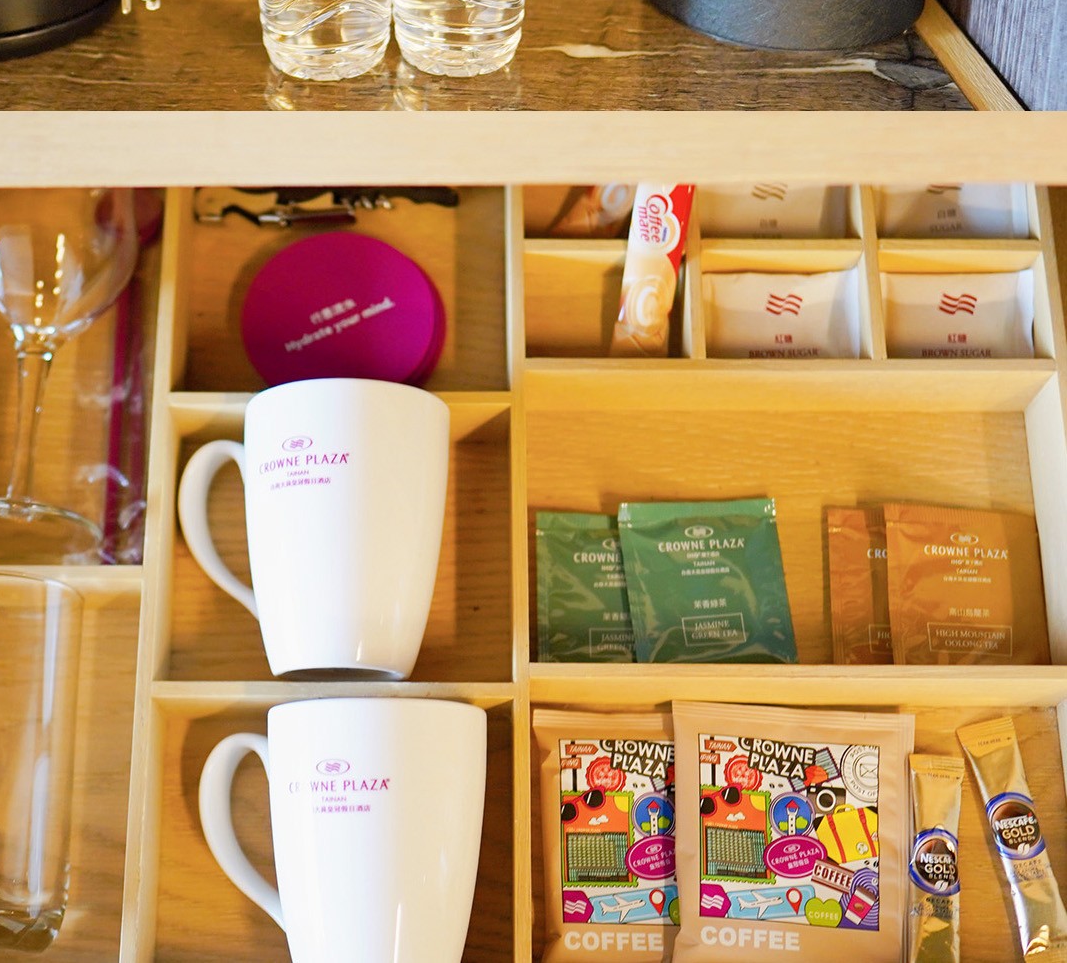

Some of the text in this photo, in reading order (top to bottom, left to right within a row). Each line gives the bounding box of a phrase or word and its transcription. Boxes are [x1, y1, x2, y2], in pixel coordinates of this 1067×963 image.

[284, 326, 334, 353] Hydrate
[333, 313, 361, 334] your
[748, 346, 821, 359] BROWN SUGAR
[921, 348, 993, 359] BROWN SUGAR
[259, 453, 349, 475] CROWNE PLAZA
[658, 538, 745, 553] CROWNE PLAZA
[924, 545, 1008, 560] CROWNE PLAZA
[695, 620, 730, 631] JASMINE
[692, 630, 722, 640] GREEN
[936, 629, 1006, 640] HIGH MOUNTAIN
[944, 640, 982, 648] OOLONG
[569, 744, 594, 753] TAINAN
[602, 740, 675, 762] CROWNE
[708, 741, 732, 750] TAINAN
[740, 738, 815, 764] CROWNE
[612, 753, 667, 779] PLAZA
[749, 754, 805, 779] PLAZA
[289, 778, 389, 793] CRWNE PLAZA
[1002, 825, 1035, 840] GOLD
[1009, 835, 1033, 845] BLEND
[633, 855, 659, 868] CROWNE
[771, 847, 820, 866] CROWNE PLAZA
[813, 863, 852, 889] COFFEE
[924, 864, 956, 875] GOLD
[808, 911, 839, 921] COFFEE
[564, 930, 664, 952] COFFEE
[700, 926, 801, 952] COFFEE
